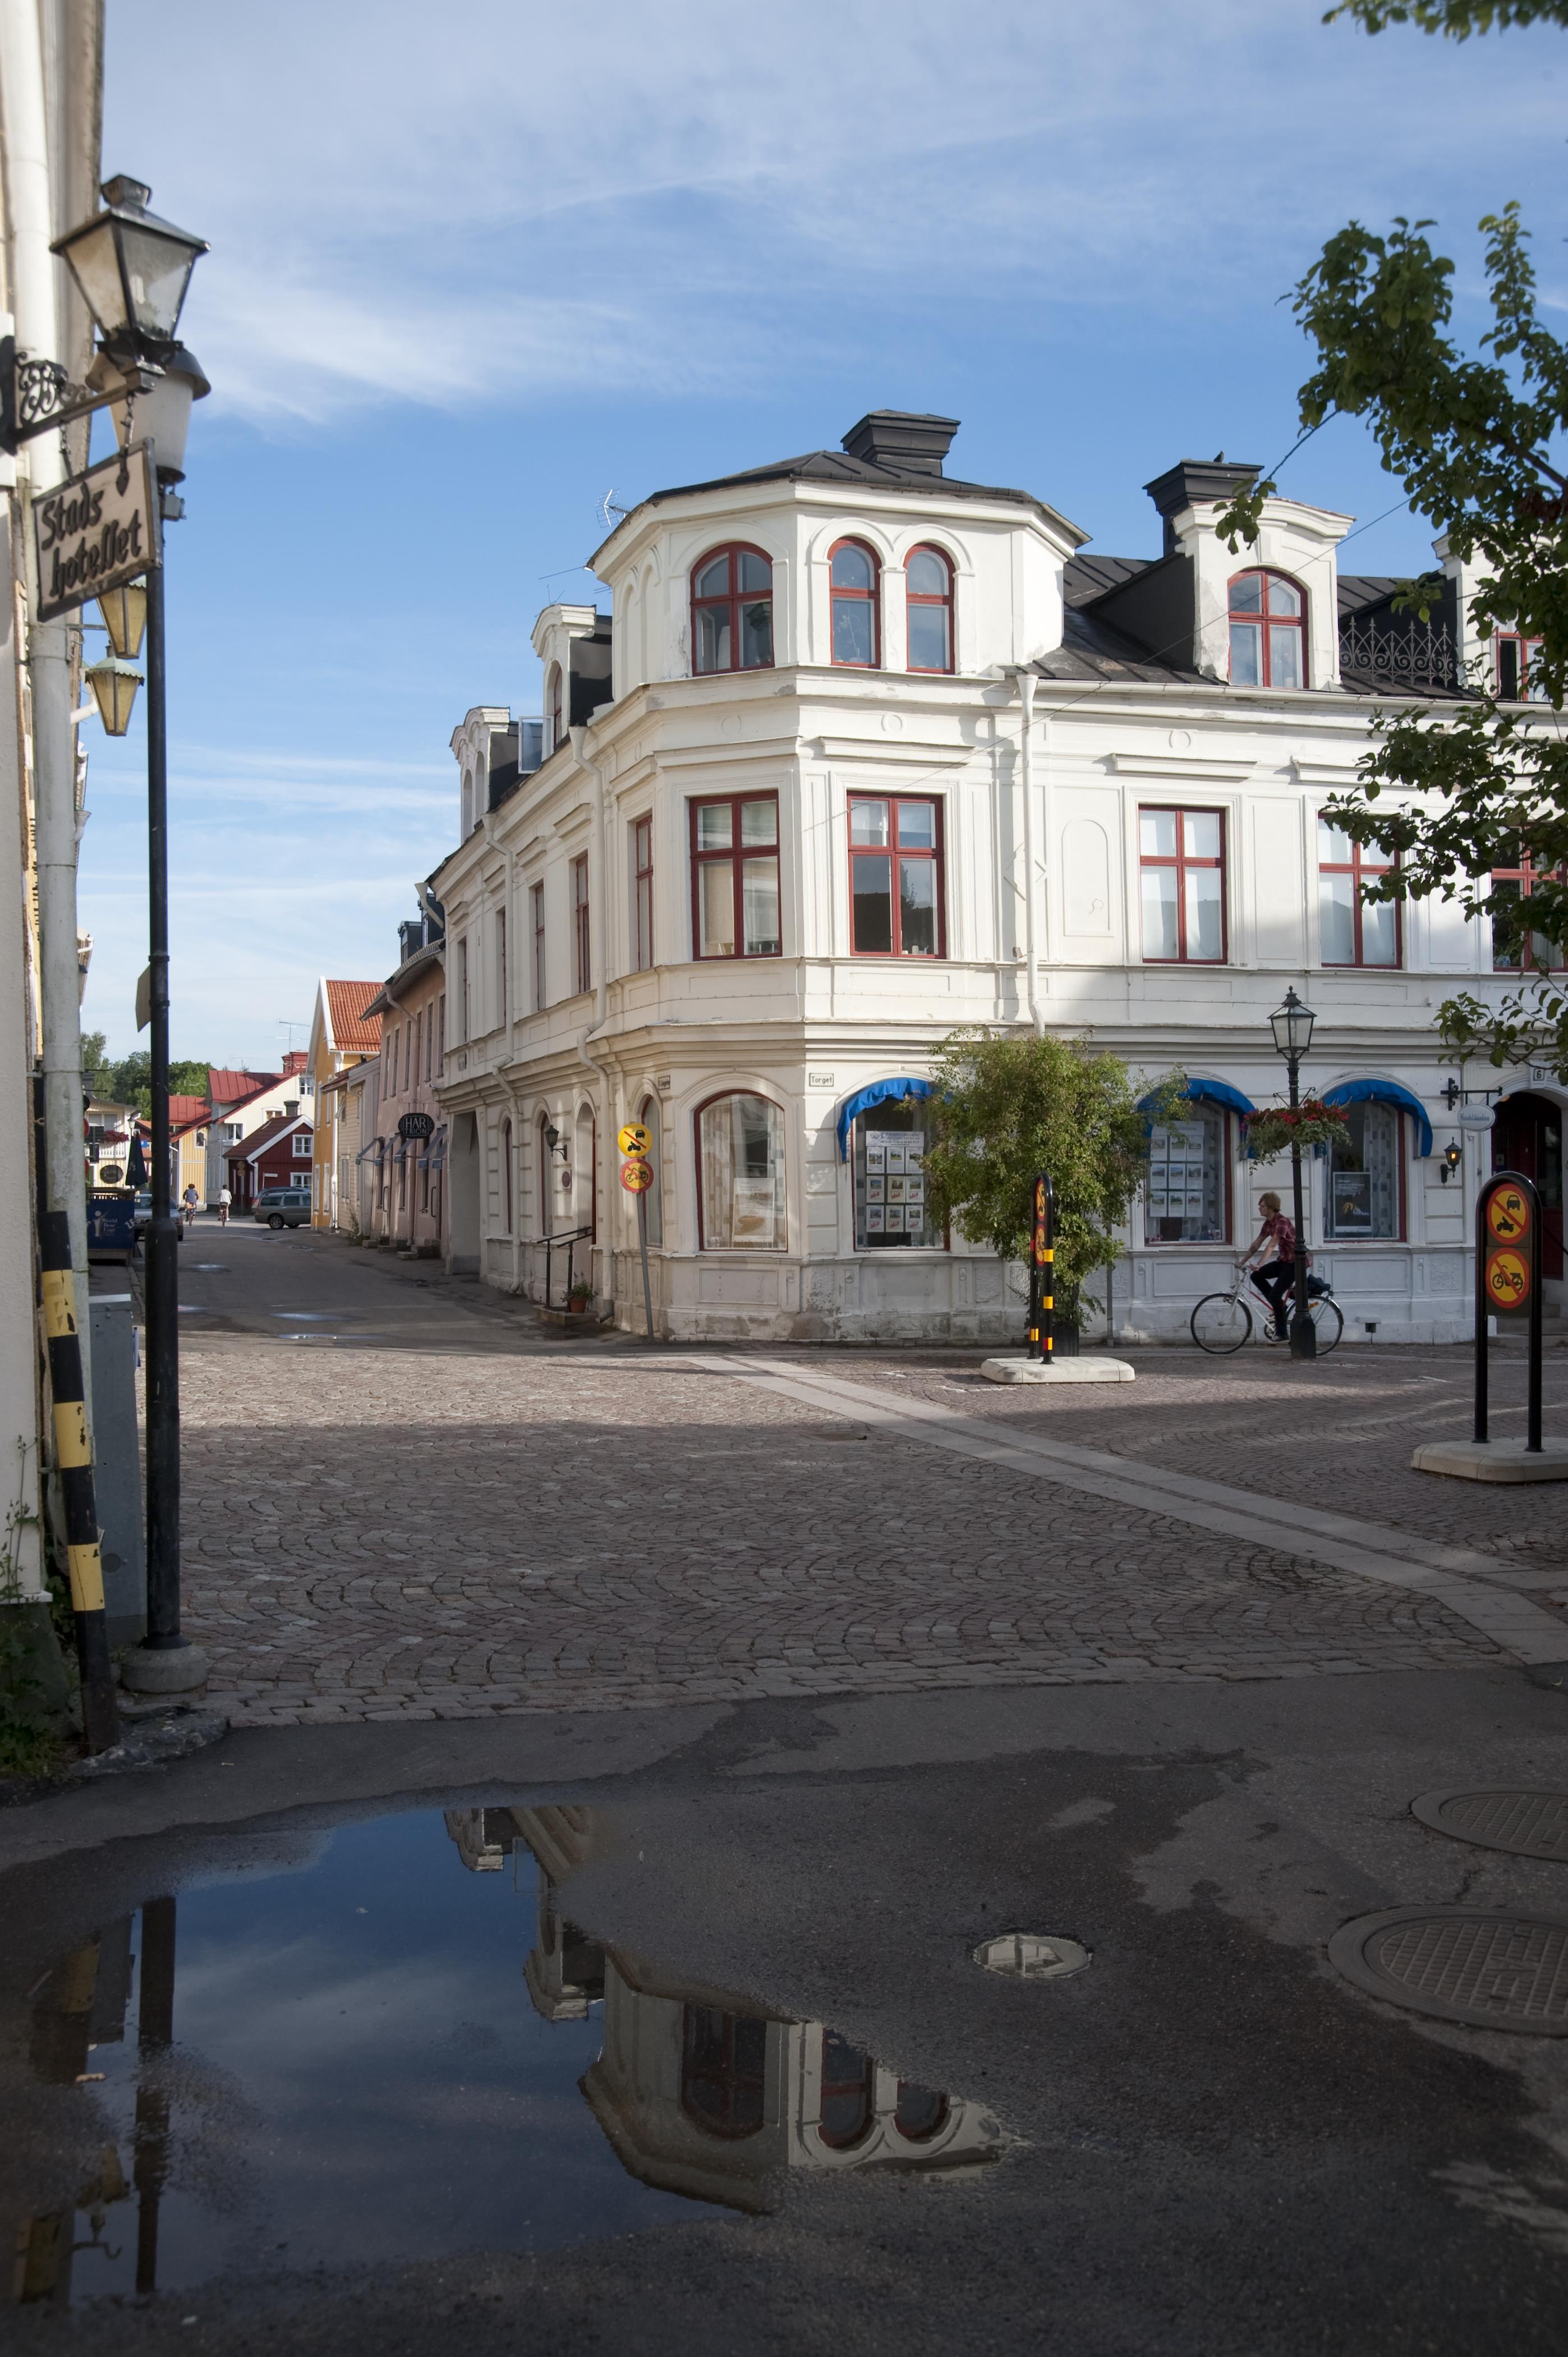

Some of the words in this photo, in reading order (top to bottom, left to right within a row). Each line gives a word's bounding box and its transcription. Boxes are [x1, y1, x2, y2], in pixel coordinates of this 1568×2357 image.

[41, 481, 104, 551] Stads
[49, 508, 142, 600] hotellet
[1537, 1070, 1542, 1079] 6
[1460, 1113, 1489, 1122] Handelsbanken
[405, 1118, 426, 1128] HAR
